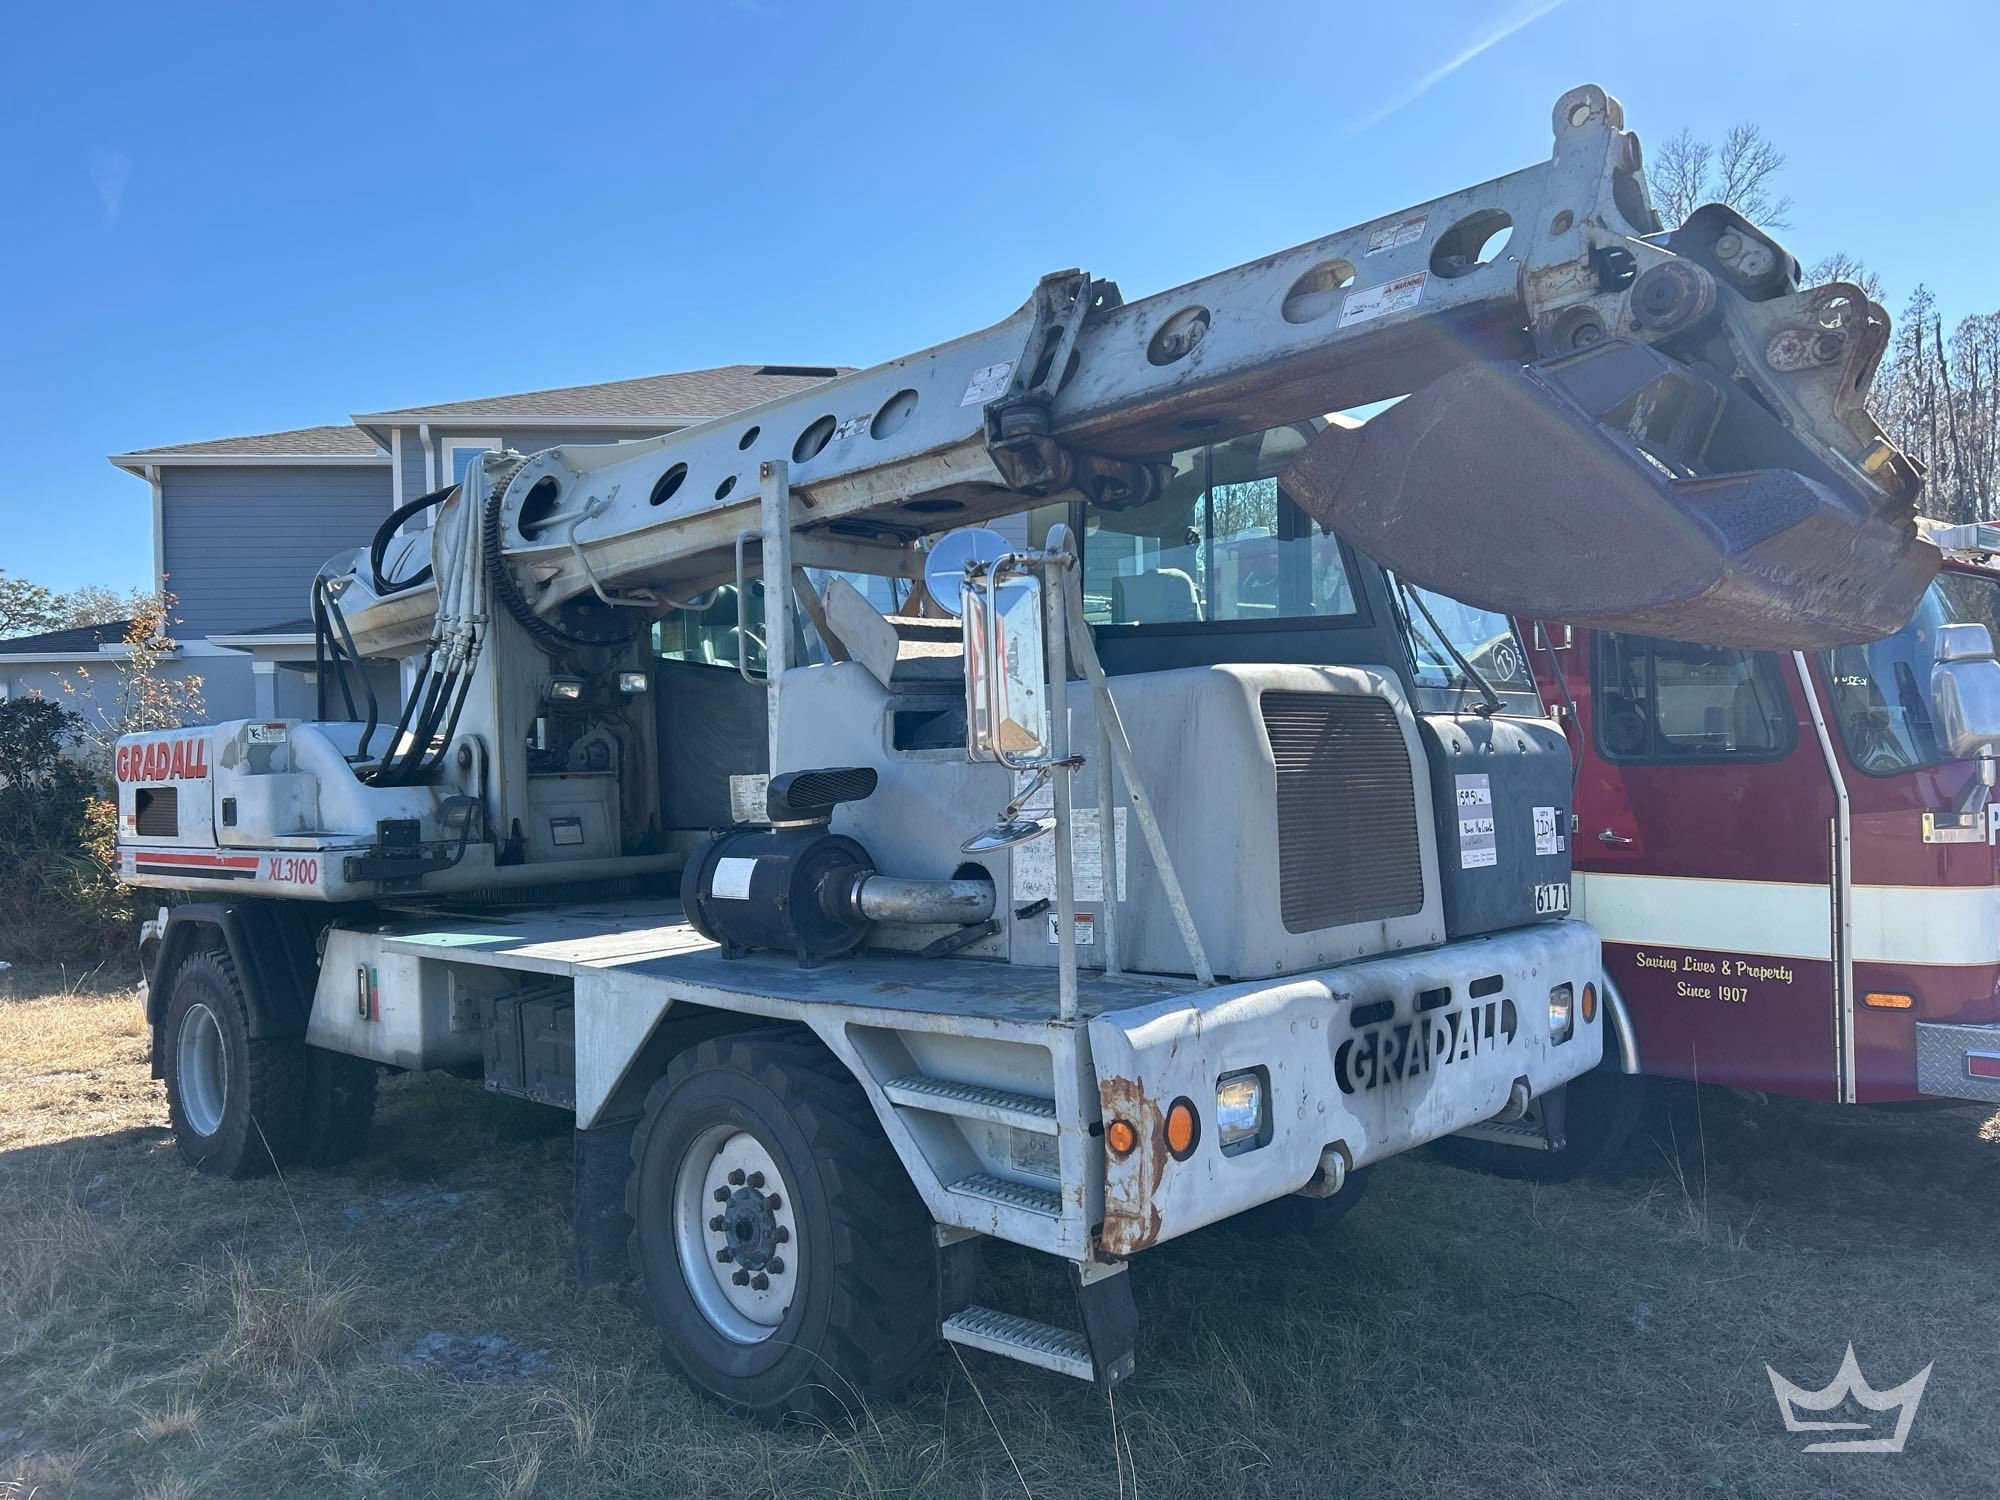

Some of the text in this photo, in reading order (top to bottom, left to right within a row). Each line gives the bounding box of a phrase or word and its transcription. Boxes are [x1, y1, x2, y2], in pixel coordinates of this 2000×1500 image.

[1497, 649, 1513, 676] 13
[116, 738, 208, 783] GRADALL
[268, 856, 318, 885] XL3100
[1536, 885, 1568, 912] 6171
[1636, 952, 1793, 985] Saving Lives & Property
[1677, 982, 1748, 1003] Since 1907
[1342, 997, 1510, 1093] GRADALL
[1030, 1139, 1049, 1152] GSE
